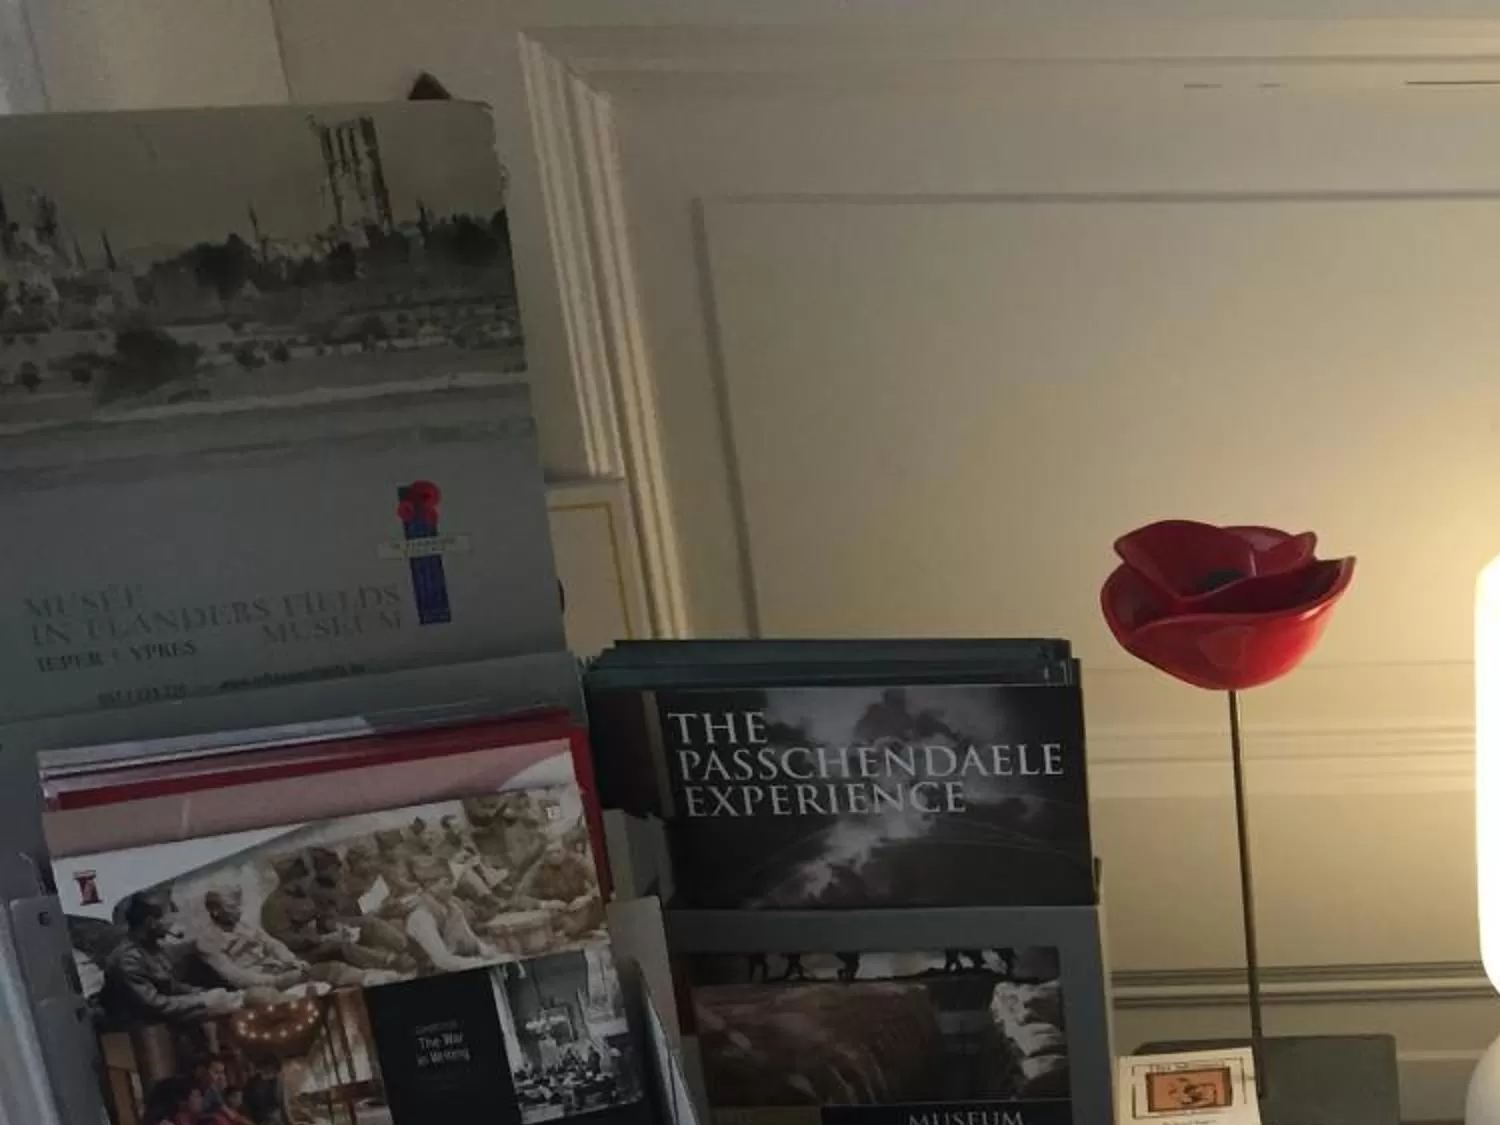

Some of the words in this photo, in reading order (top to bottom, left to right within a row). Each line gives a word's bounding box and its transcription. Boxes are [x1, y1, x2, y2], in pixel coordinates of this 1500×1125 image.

[667, 711, 767, 745] THE
[677, 743, 1065, 782] PASSCHENDAELE
[685, 781, 967, 817] EXPERIENCE
